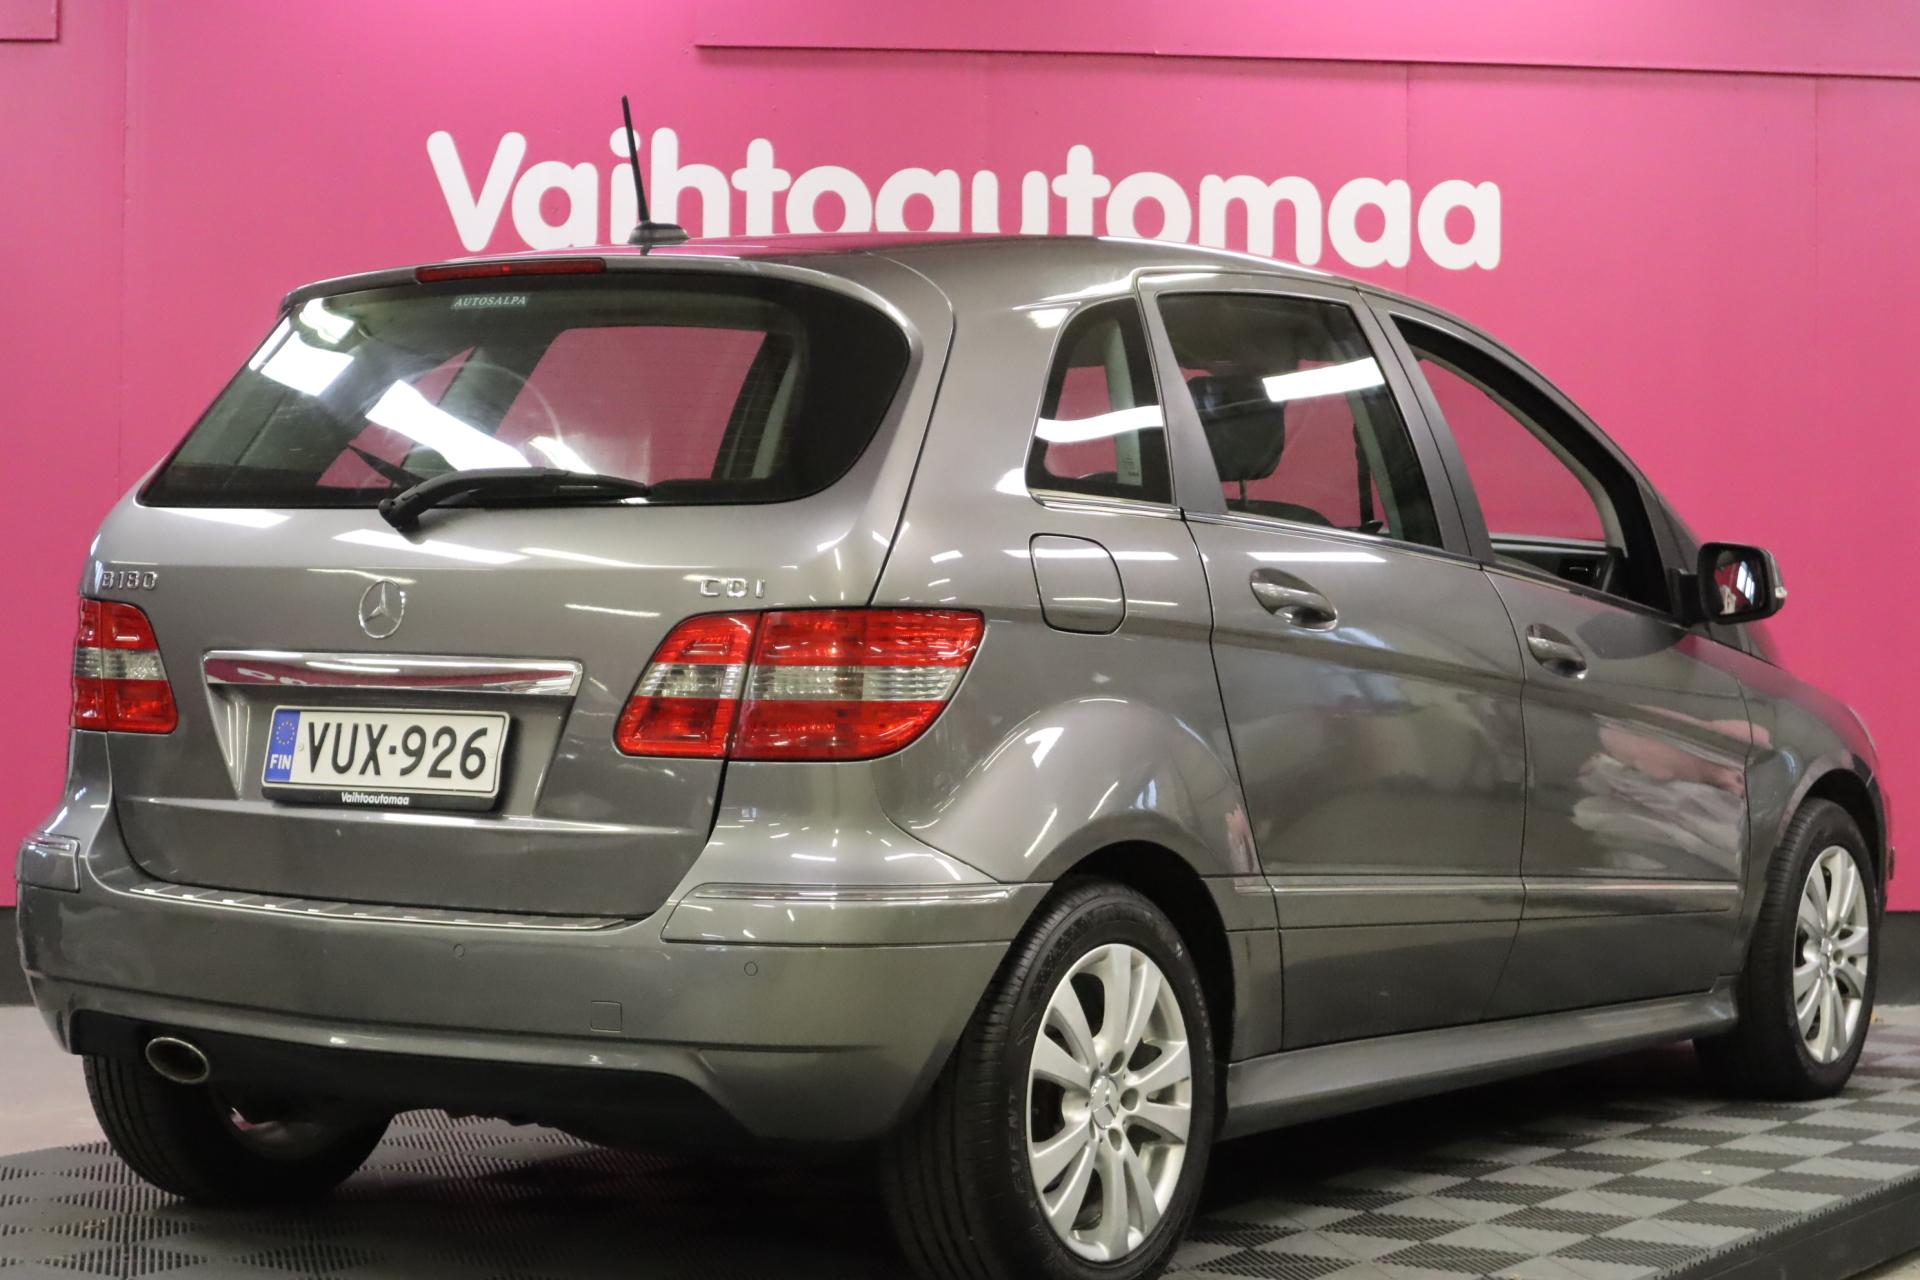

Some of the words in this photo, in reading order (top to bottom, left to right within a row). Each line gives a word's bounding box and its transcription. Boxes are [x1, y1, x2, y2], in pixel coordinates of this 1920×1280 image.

[426, 126, 1501, 270] Vaihtoautomaa
[454, 296, 526, 307] AUTOSALPA
[700, 576, 764, 598] CDI
[270, 754, 291, 770] FIN
[341, 792, 409, 805] Vaihtoautomaa
